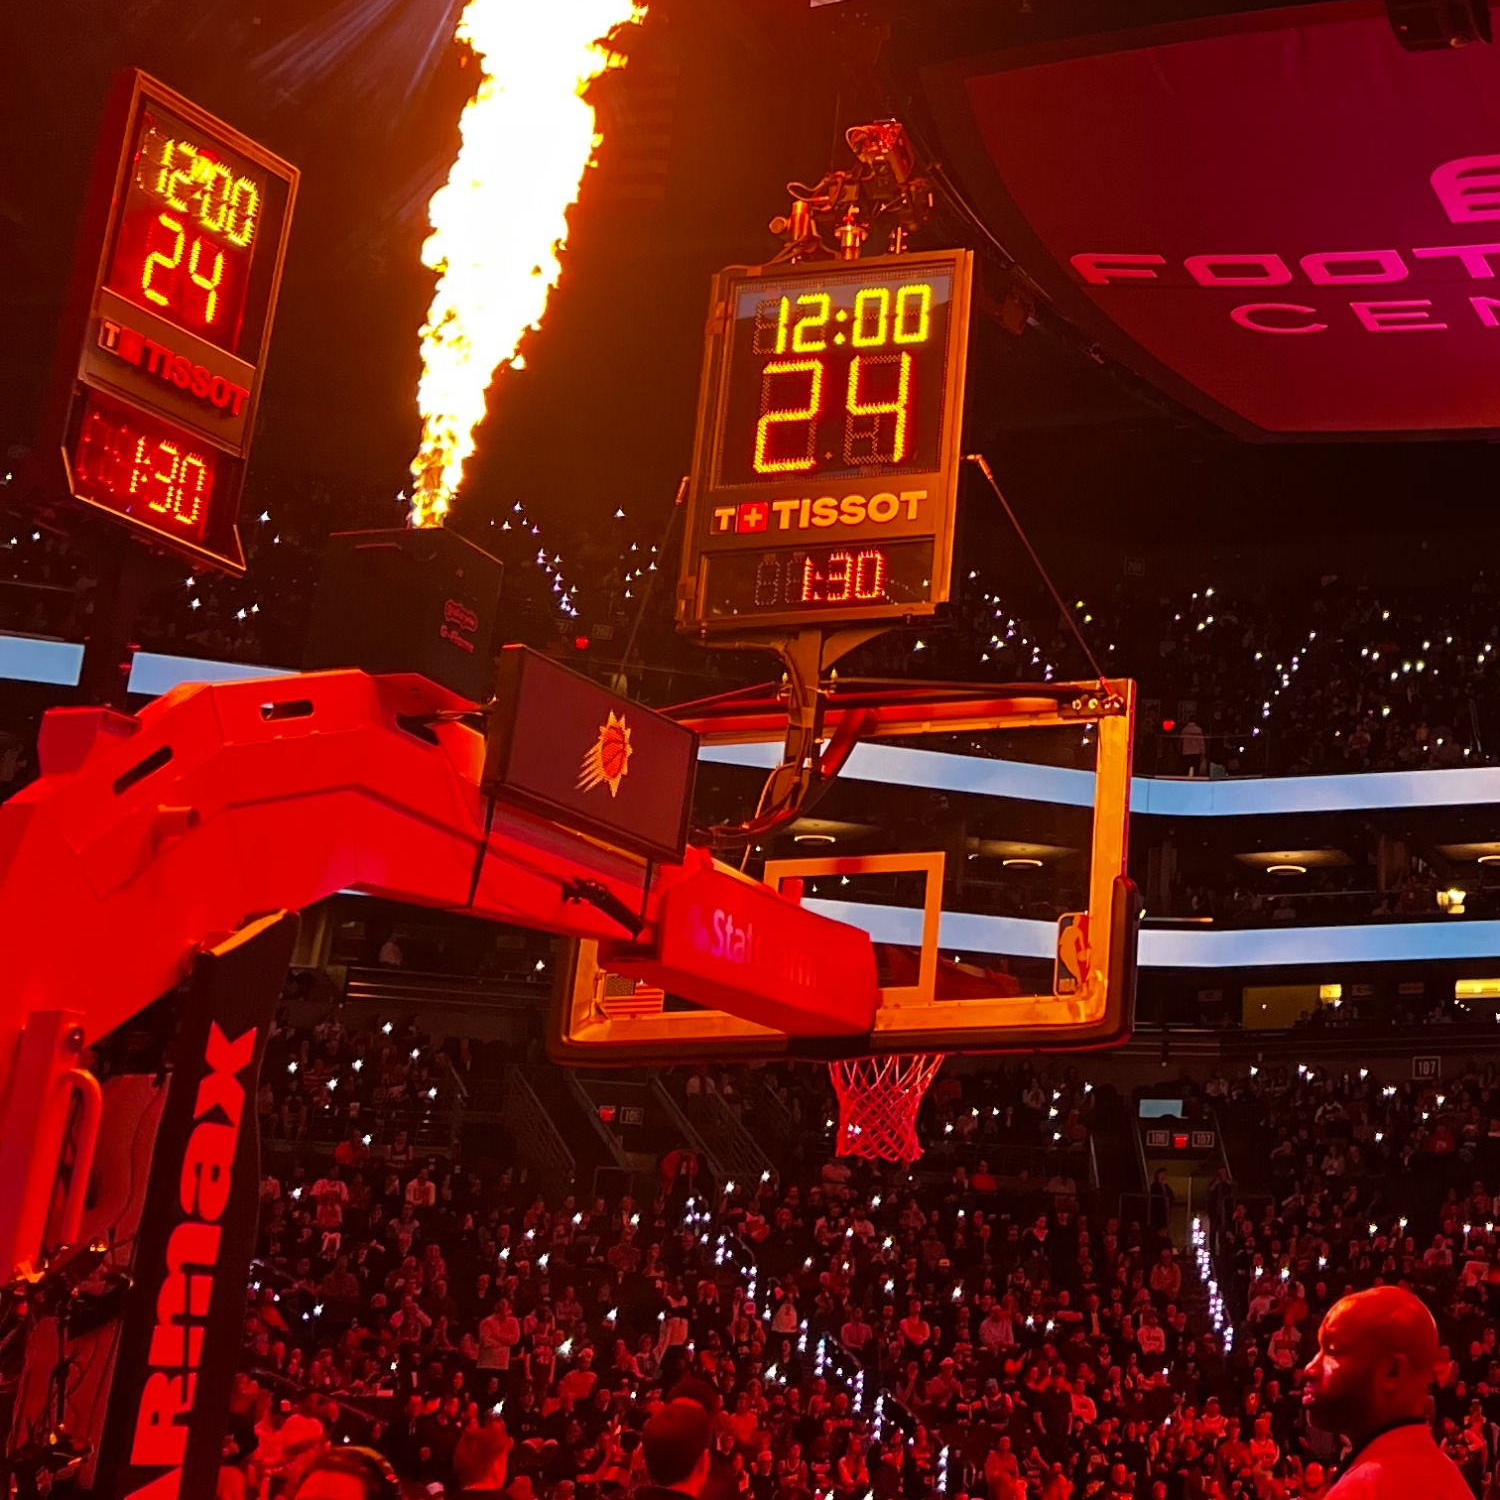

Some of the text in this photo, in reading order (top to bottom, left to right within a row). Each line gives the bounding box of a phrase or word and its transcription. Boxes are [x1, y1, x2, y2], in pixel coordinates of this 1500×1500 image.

[142, 213, 224, 323] 24
[775, 283, 932, 355] 12:00
[143, 339, 250, 416] TISSOT
[753, 351, 912, 474] 24
[772, 490, 928, 531] TISSOT
[801, 549, 886, 602] 1:30
[1418, 1060, 1437, 1075] 107
